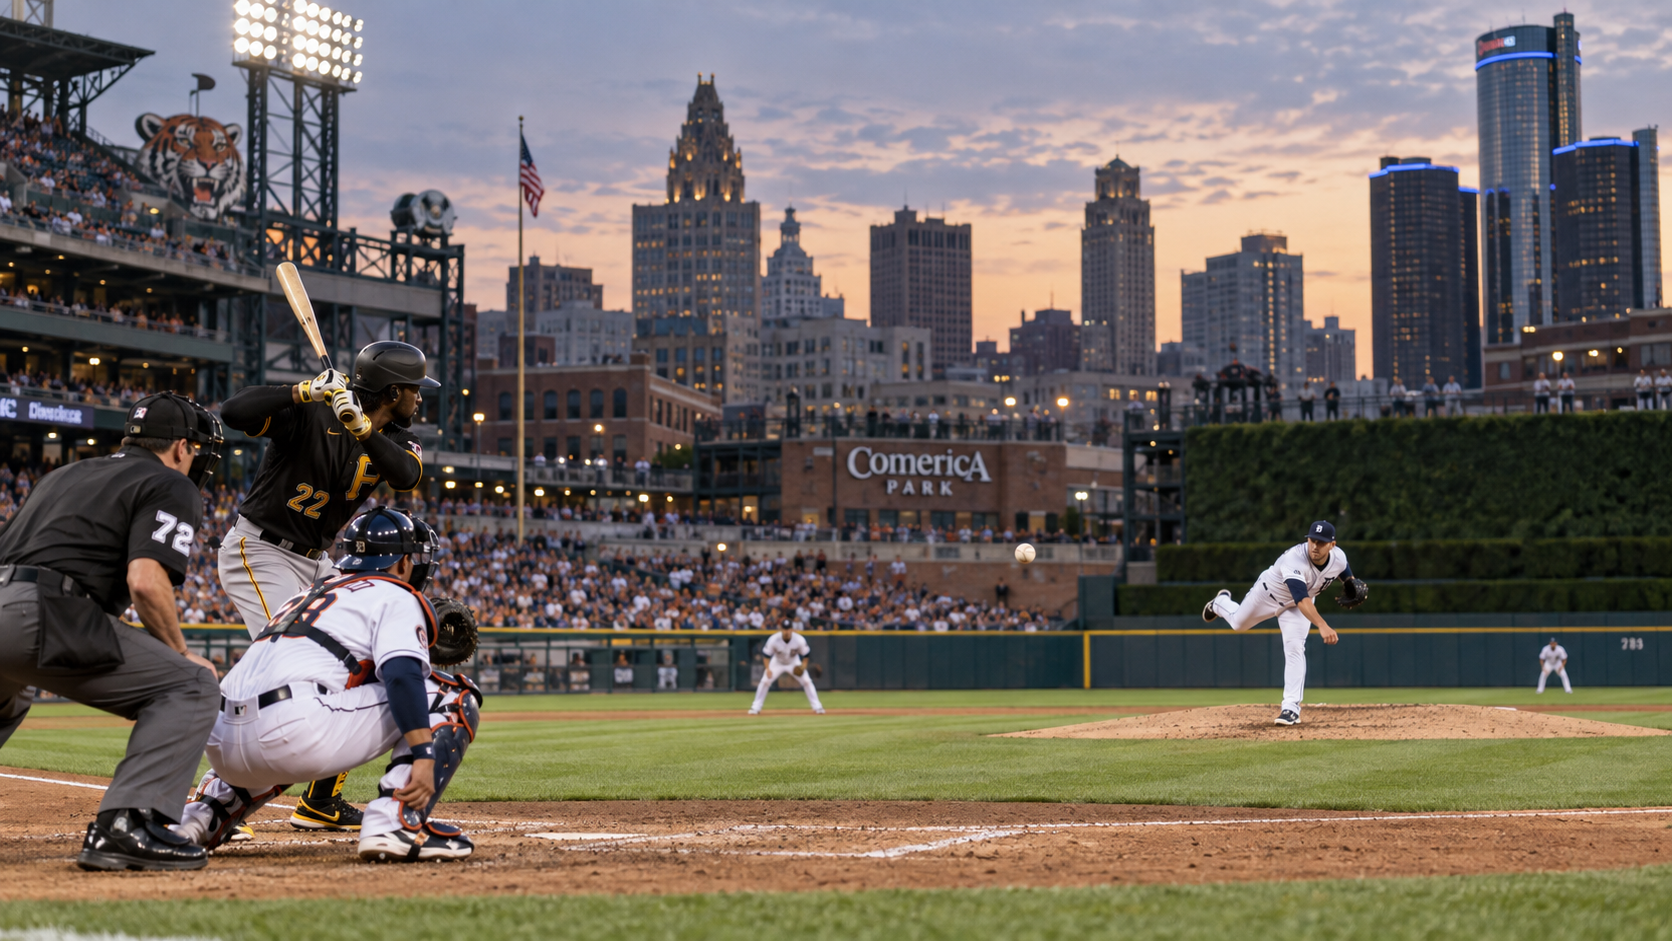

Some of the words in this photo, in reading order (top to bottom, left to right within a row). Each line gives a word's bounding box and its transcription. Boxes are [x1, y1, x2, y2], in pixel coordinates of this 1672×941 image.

[286, 482, 330, 519] 22
[886, 479, 953, 496] PARK
[151, 509, 195, 558] 72
